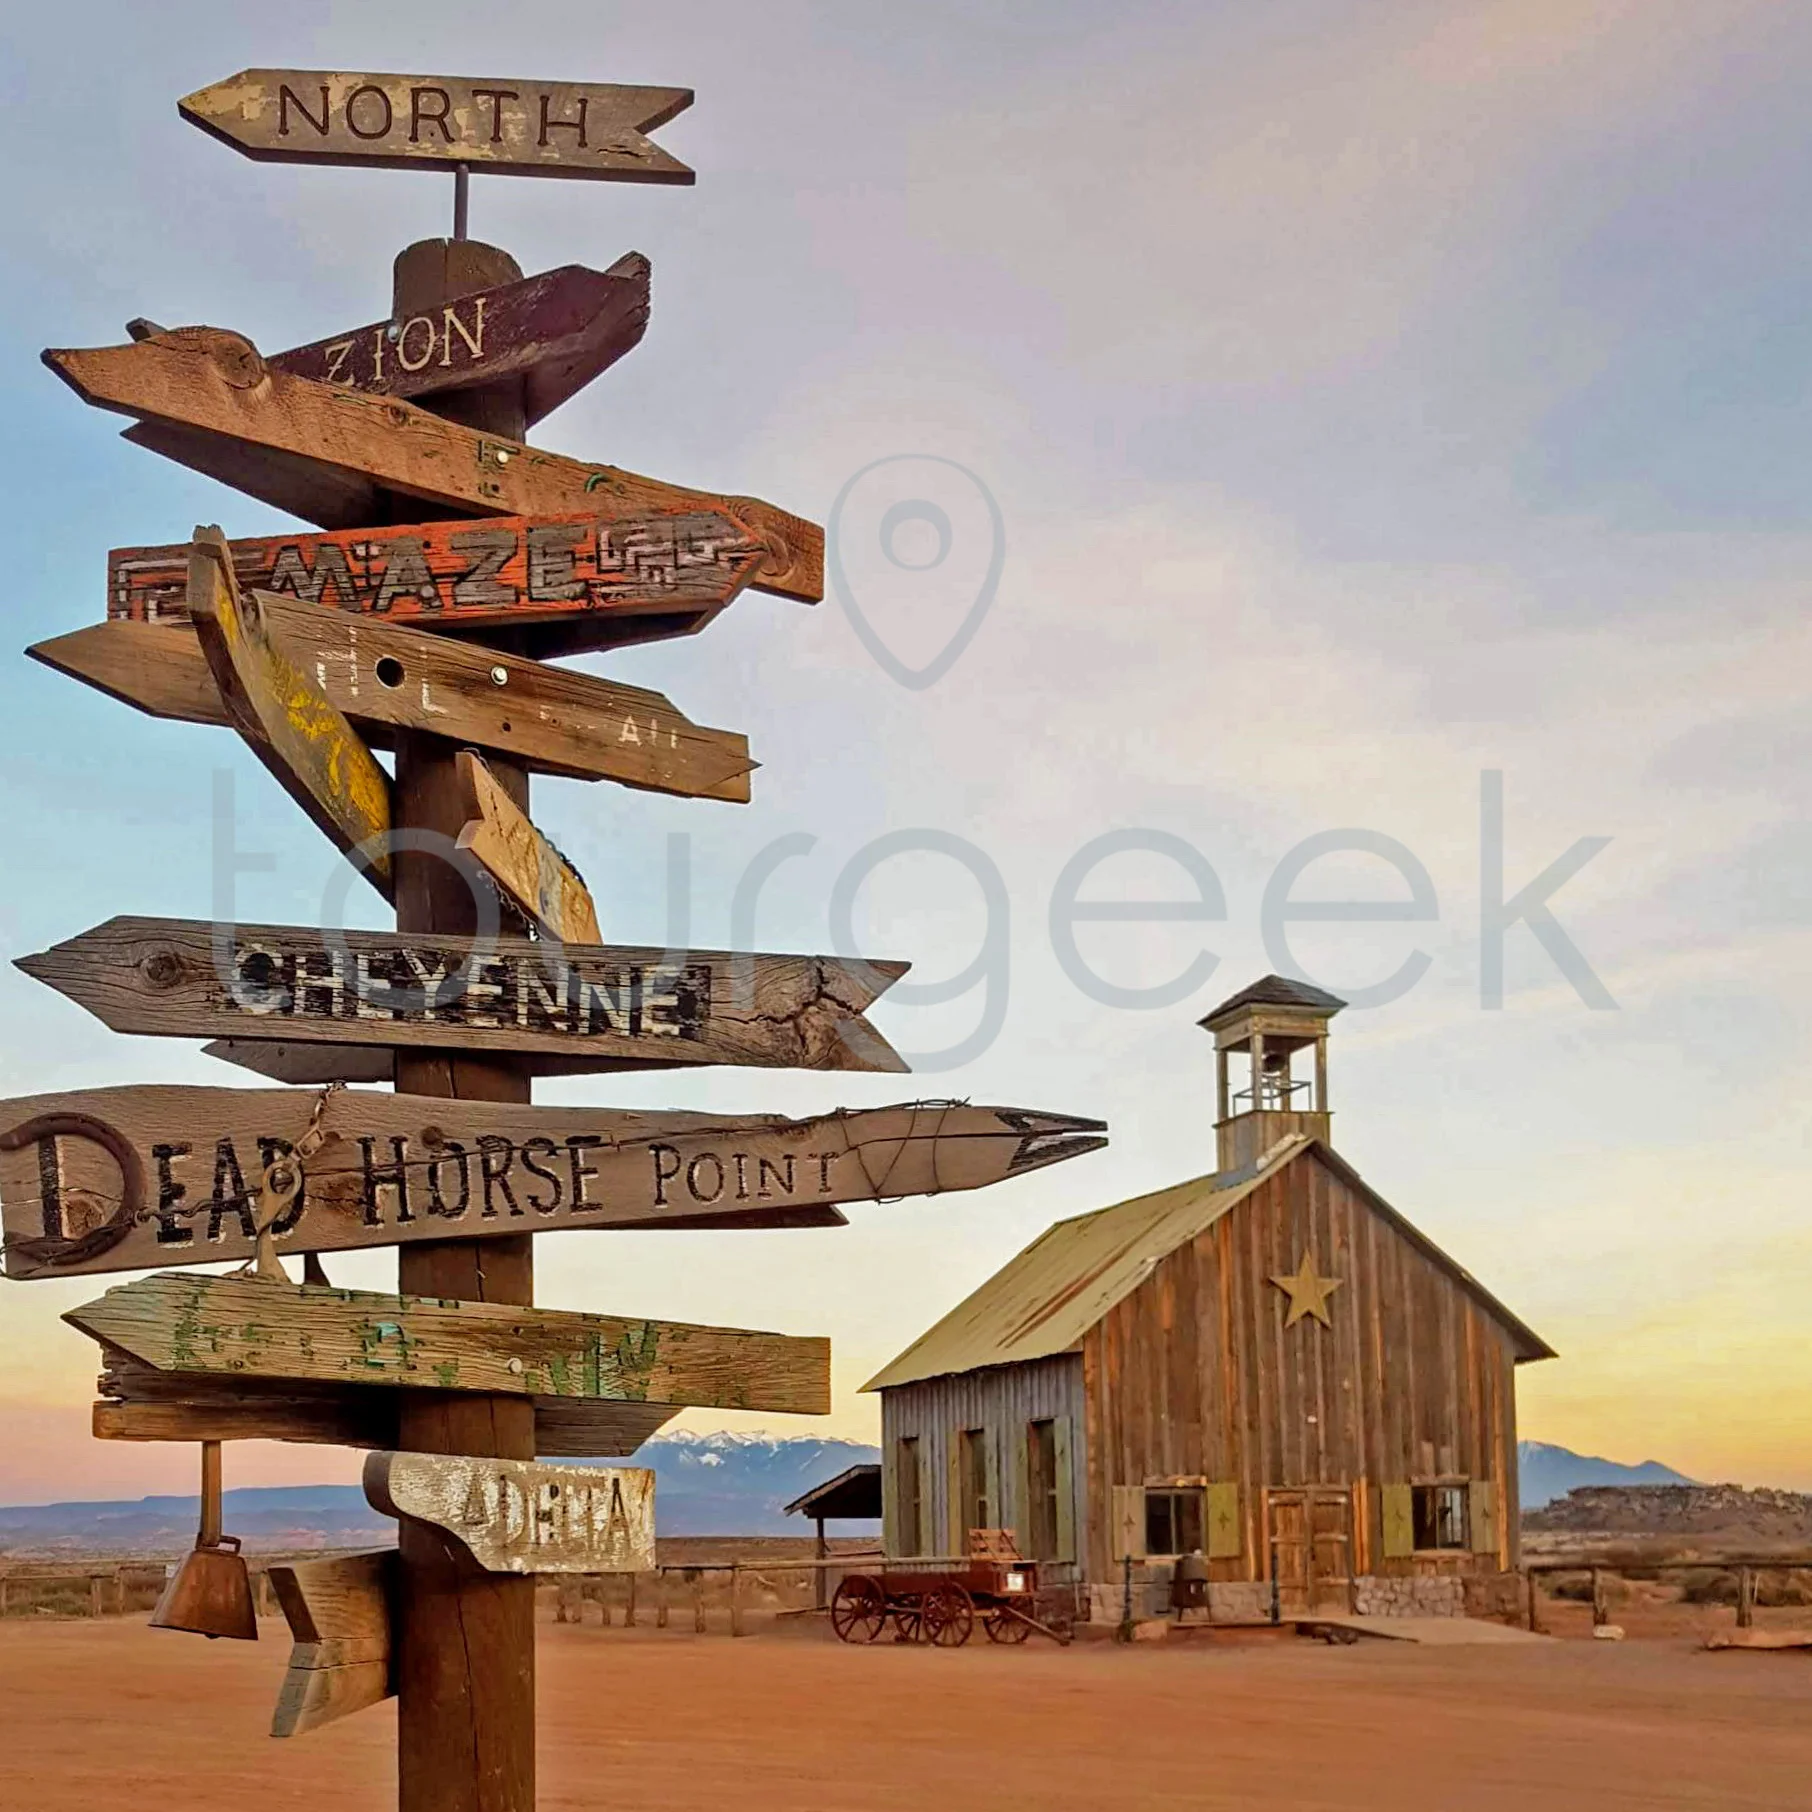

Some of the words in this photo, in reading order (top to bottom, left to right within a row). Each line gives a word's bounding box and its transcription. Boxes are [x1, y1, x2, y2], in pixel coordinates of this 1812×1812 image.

[278, 84, 589, 148] NORTH
[324, 297, 487, 388] ZION
[270, 521, 588, 612] MAZE
[232, 943, 684, 1038] CHEYENNE
[0, 1111, 309, 1266] DEAD
[357, 1134, 604, 1230] HORSE
[648, 1142, 839, 1210] POINT
